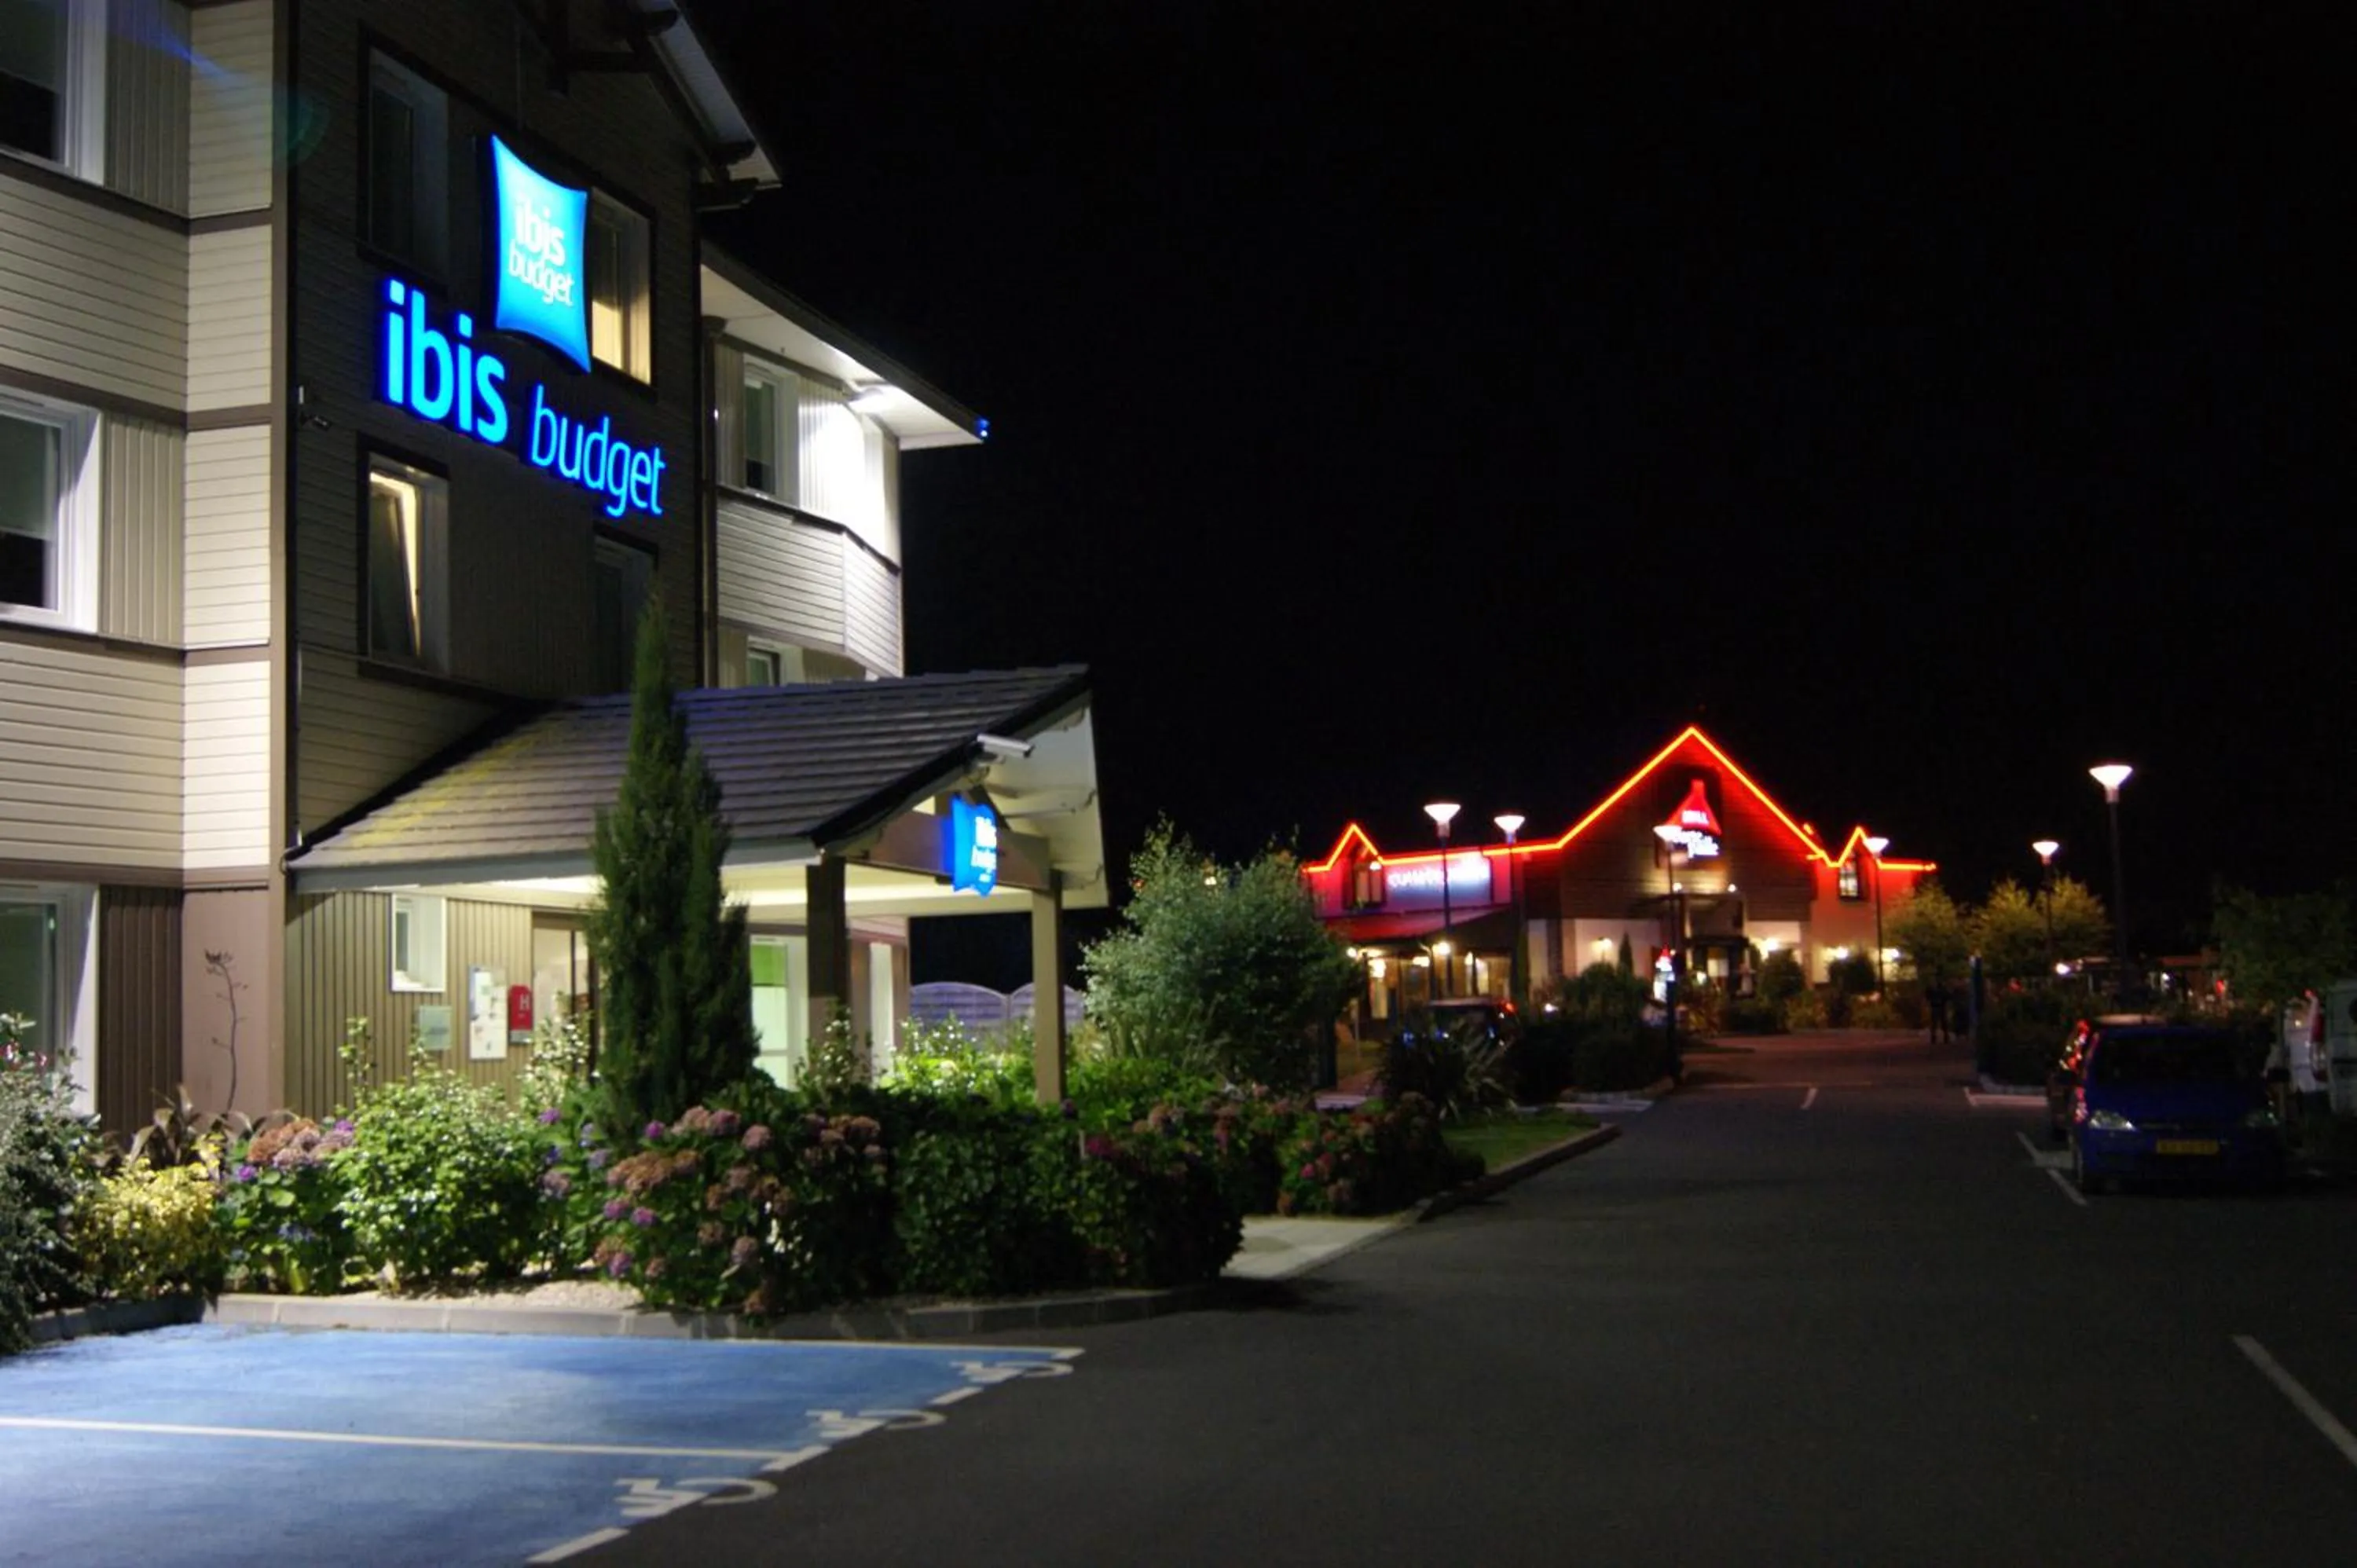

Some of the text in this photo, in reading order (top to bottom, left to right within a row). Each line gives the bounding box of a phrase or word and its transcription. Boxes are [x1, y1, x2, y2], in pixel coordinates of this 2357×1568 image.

[515, 193, 566, 266] ibis
[508, 239, 575, 306] budget
[388, 278, 666, 518] ibis budget
